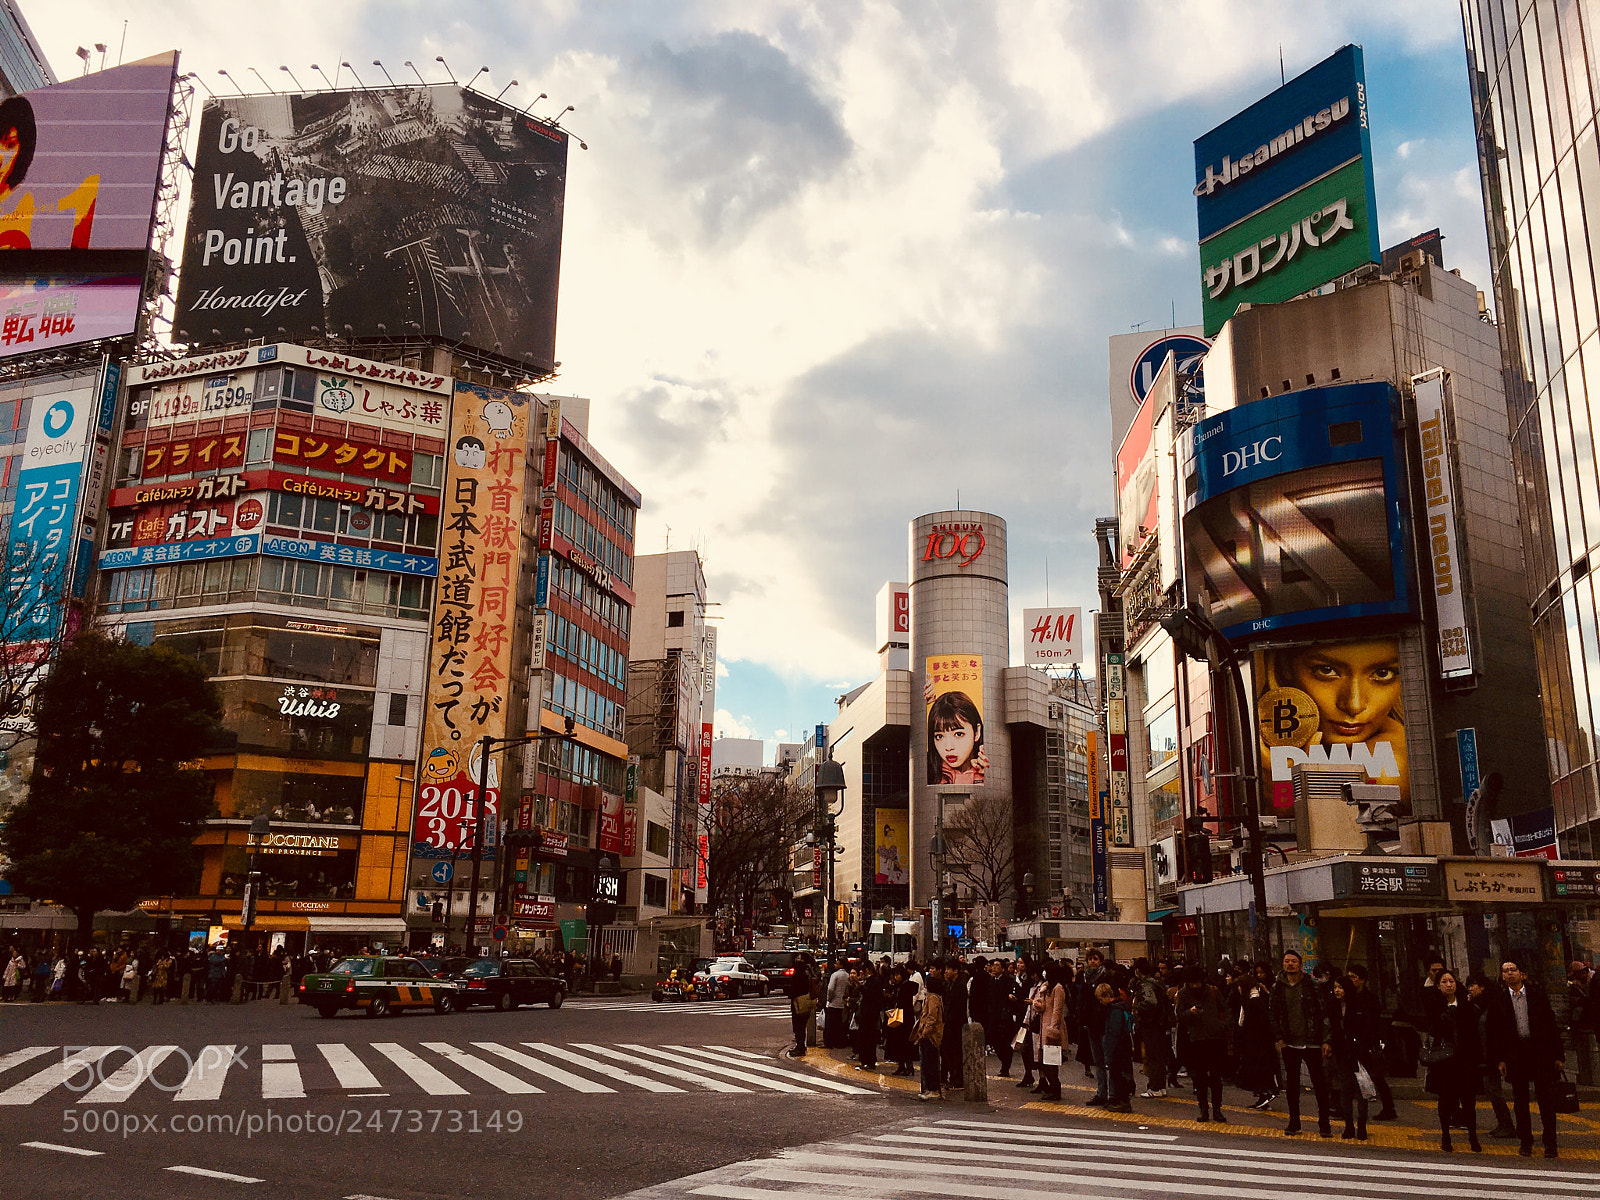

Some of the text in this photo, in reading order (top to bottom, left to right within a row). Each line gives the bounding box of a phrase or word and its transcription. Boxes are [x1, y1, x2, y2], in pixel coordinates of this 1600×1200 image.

[1356, 82, 1368, 129] サロンパス
[218, 117, 258, 154] Go
[525, 121, 563, 142] HONDA
[1192, 96, 1350, 197] Hisamitsu
[213, 173, 347, 214] Vantage
[202, 228, 296, 266] Point.
[1203, 196, 1354, 300] サロンパス
[189, 286, 309, 317] HondaJet
[1, 291, 79, 346] 転職
[141, 351, 250, 380] しゃぶしゃぶバイキング
[306, 350, 446, 390] しゃぶしゃぶバイキング
[131, 400, 149, 416] 9F
[204, 386, 252, 414] 1,599円
[362, 389, 443, 425] しゃぶ葉
[1193, 421, 1224, 447] Channel
[31, 439, 78, 460] eyecity
[146, 436, 242, 470] プライス
[275, 433, 408, 474] コンタクト
[1221, 435, 1283, 478] DHC
[90, 461, 103, 509] 献血ルーム
[196, 474, 246, 500] ガスト
[239, 512, 260, 522] ガスト
[364, 488, 425, 516] ガスト
[1420, 408, 1454, 597] Taisei neon
[111, 520, 134, 540] 7F
[138, 517, 165, 532] Café
[165, 508, 228, 542] ガスト
[541, 519, 551, 545] ガスト
[931, 523, 984, 533] SHIBUYA
[103, 538, 251, 564] AEON 英会話イーオン 6F
[269, 539, 434, 573] AEON 英会話イーオン
[921, 531, 986, 567] 109
[469, 442, 522, 725] 打首獄門同好会が
[594, 565, 614, 591] ガスト
[434, 477, 481, 741] 日本武道館だって。
[1030, 614, 1075, 644] H&M
[1252, 619, 1271, 631] DHC
[1035, 649, 1062, 658] 150m
[704, 654, 714, 693] CAMERA
[278, 696, 341, 719] Ushi8
[700, 755, 710, 795] TaxFree
[1269, 740, 1401, 782] DMM
[246, 832, 339, 849] L'OCCITANE
[278, 849, 322, 857] PROVENCE
[1360, 877, 1404, 892] 渋谷駅
[1453, 878, 1506, 893] しぶちか
[292, 901, 330, 909] L'OCCITANE
